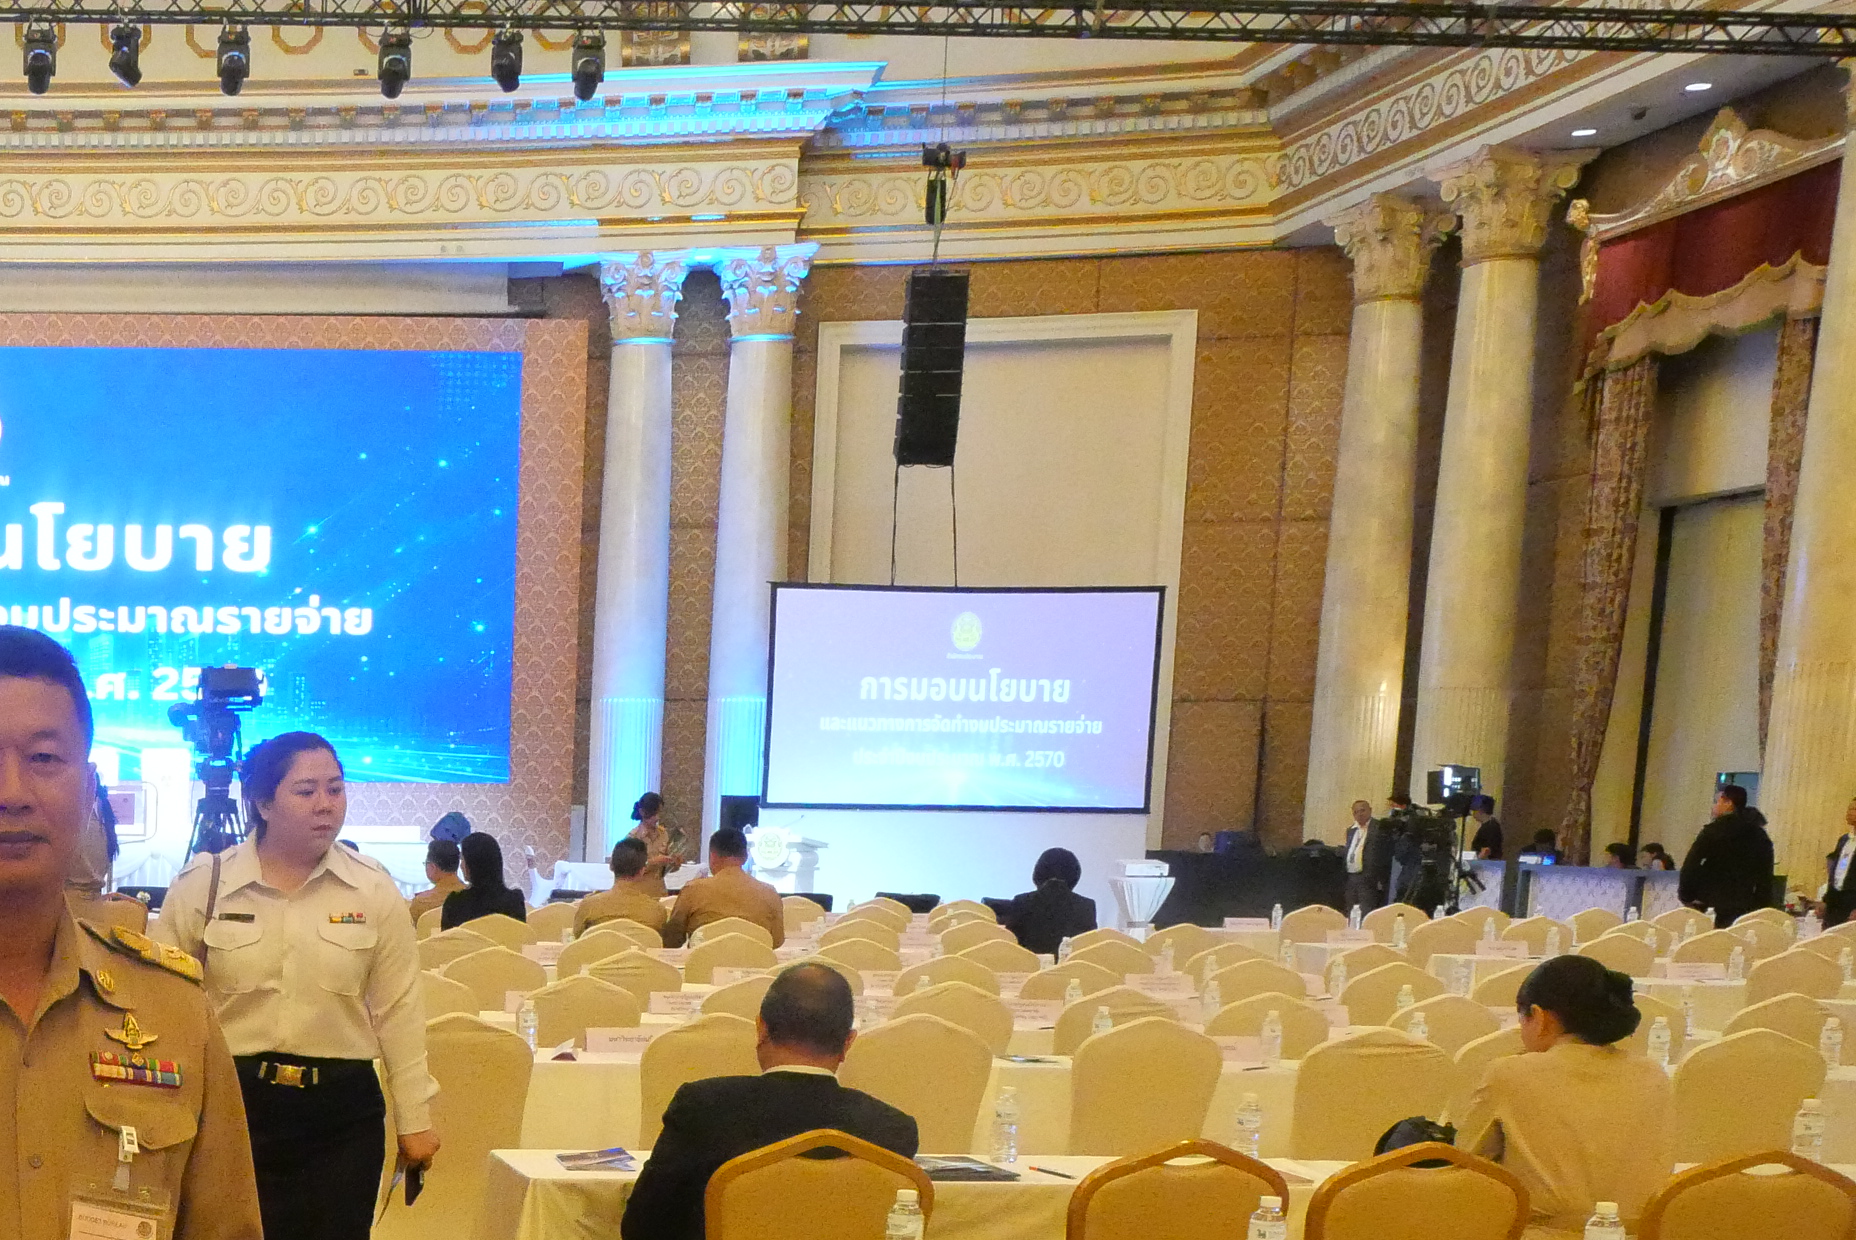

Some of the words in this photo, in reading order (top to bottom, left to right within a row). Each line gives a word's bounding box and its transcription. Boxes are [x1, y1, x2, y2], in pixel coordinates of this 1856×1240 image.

[860, 668, 1071, 704] การมอบนโยบาย
[1024, 750, 1065, 768] 2570
